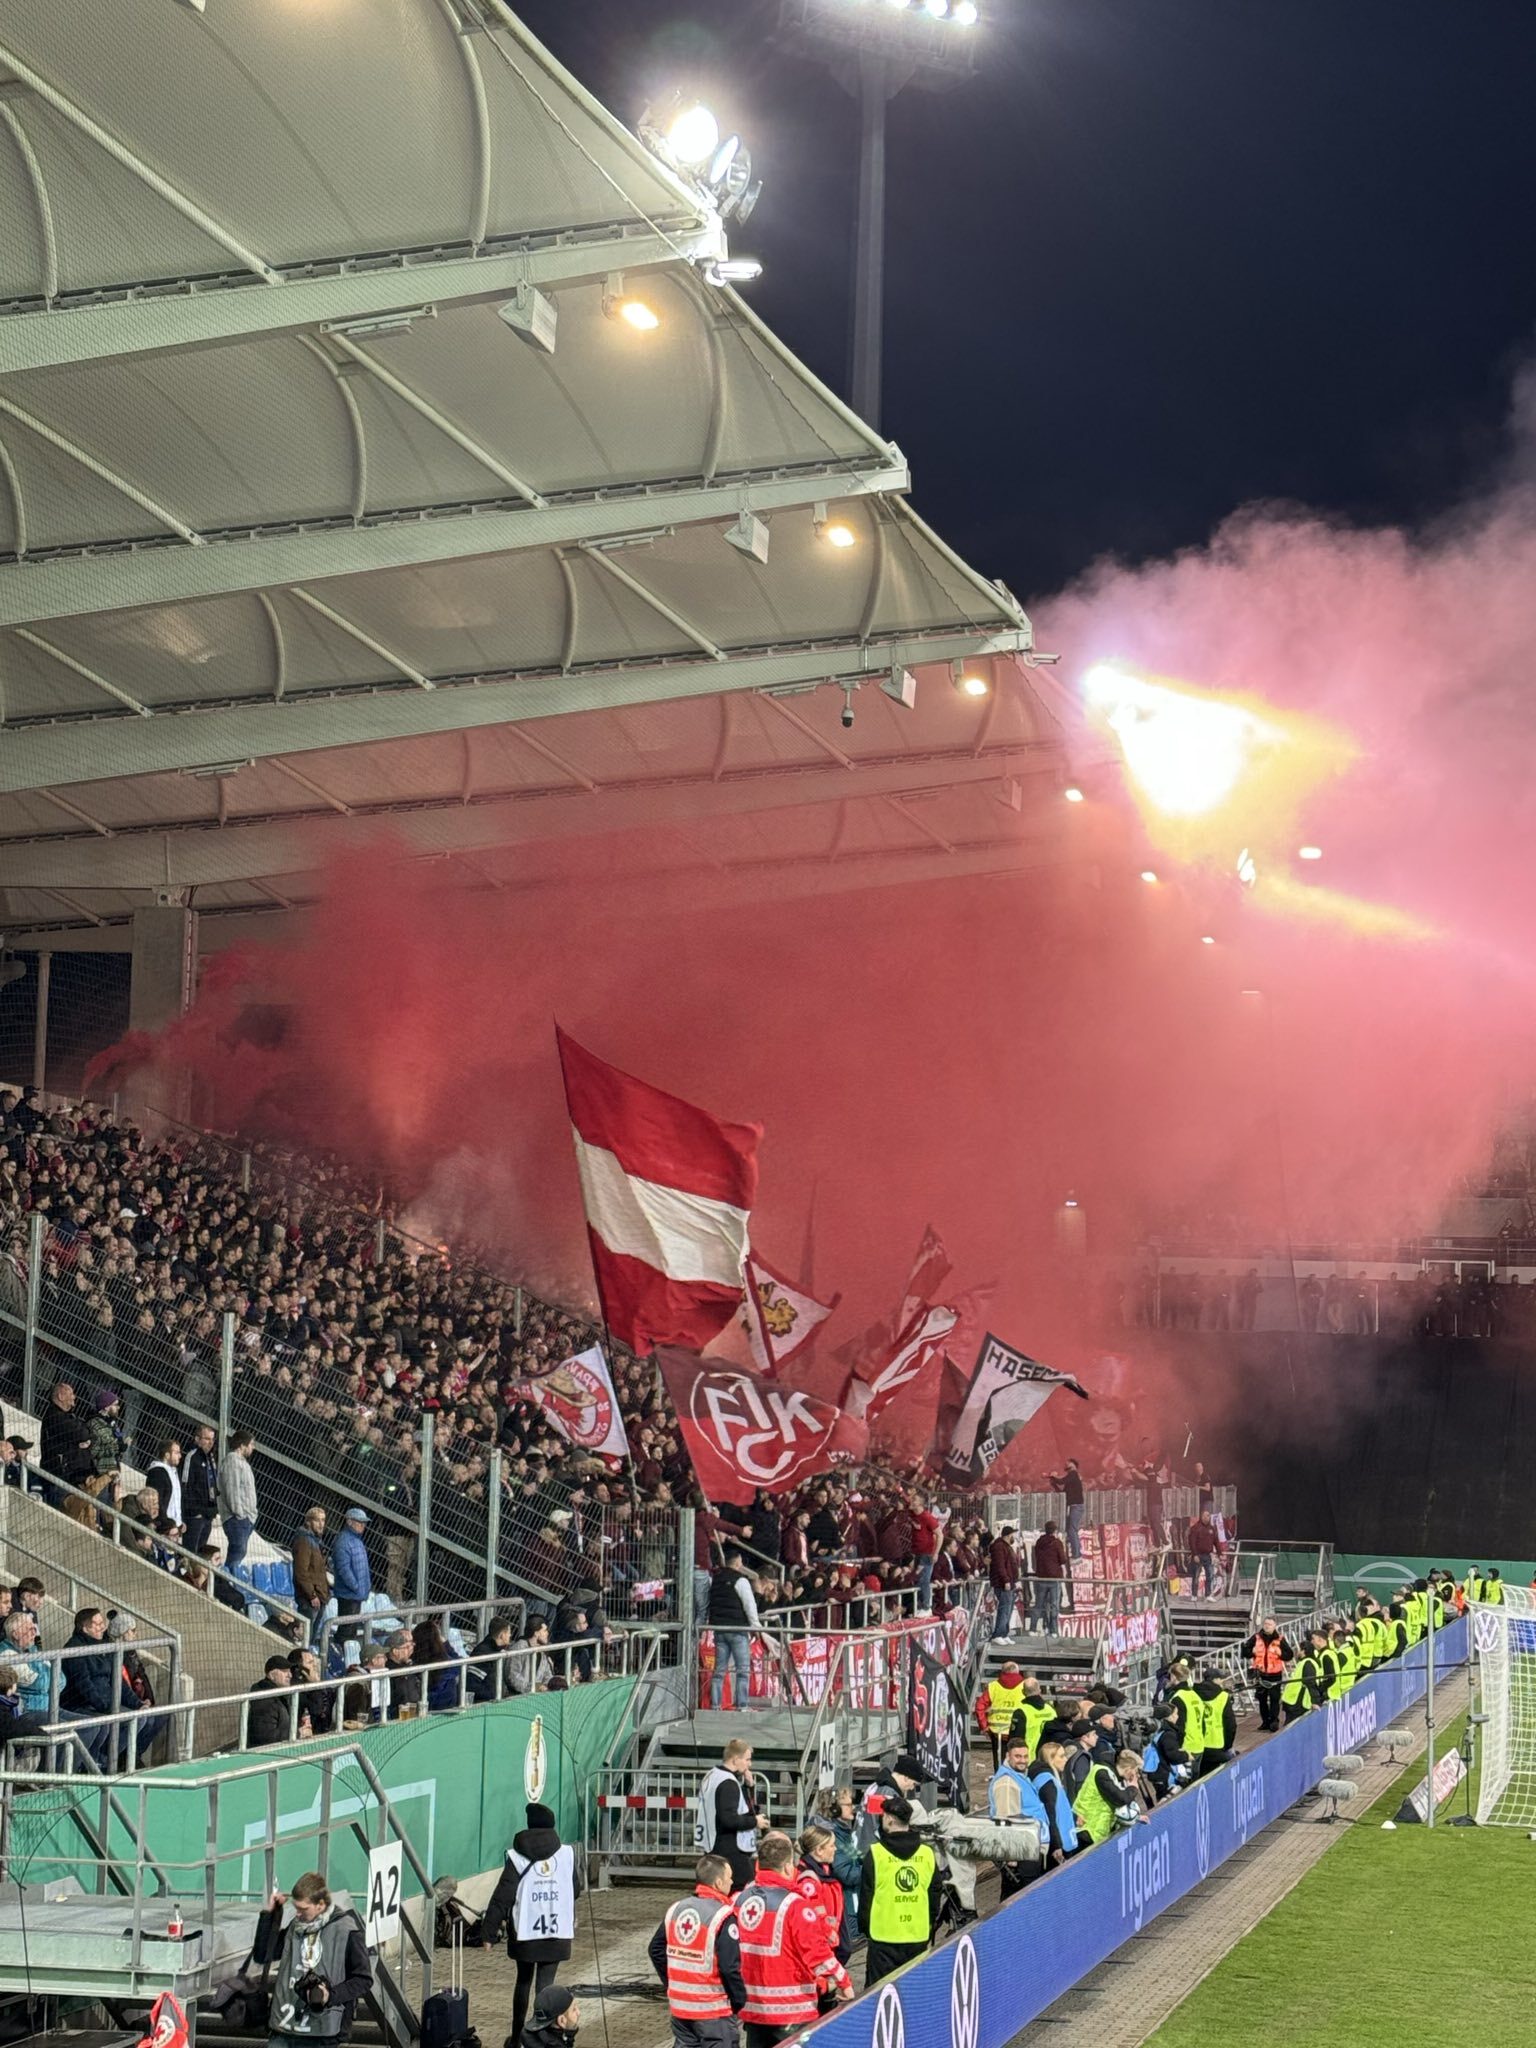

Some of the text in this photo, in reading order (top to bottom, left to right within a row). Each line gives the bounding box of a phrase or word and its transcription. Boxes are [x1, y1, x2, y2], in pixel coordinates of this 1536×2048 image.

[1336, 1690, 1377, 1757] Volkswagen
[1231, 1761, 1265, 1845] Tiguan
[369, 1865, 399, 1923] A2
[1117, 1829, 1171, 1932] Tiguan
[532, 1913, 559, 1934] 43
